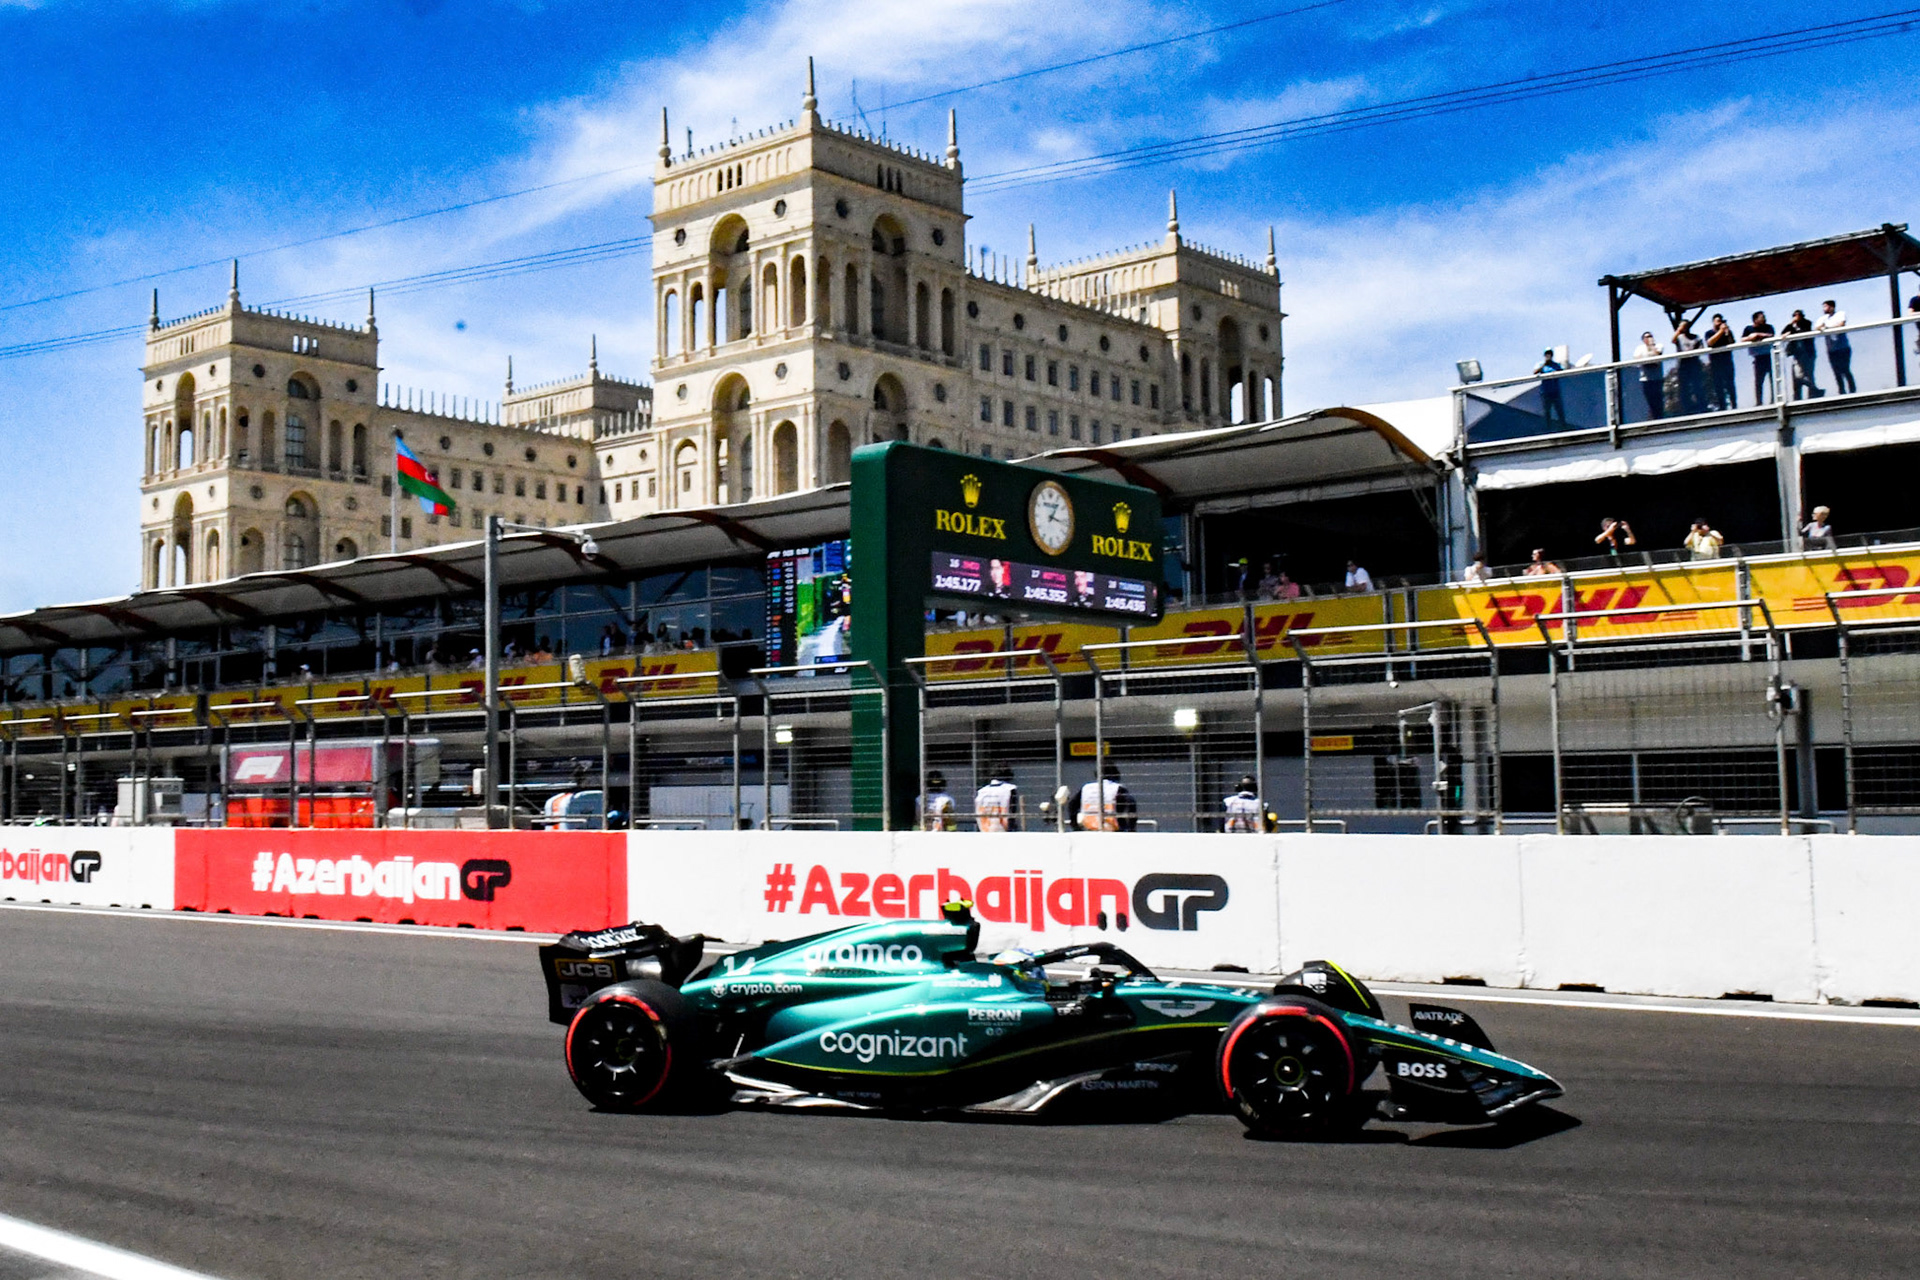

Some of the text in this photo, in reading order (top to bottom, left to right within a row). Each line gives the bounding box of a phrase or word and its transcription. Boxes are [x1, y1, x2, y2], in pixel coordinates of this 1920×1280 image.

[935, 508, 1007, 540] ROLEX
[1092, 534, 1154, 562] ROLEX
[934, 574, 982, 592] 1:45.177
[1024, 585, 1067, 603] 1:45.352
[1485, 585, 1660, 633] DHL
[1181, 612, 1327, 655] DHL
[952, 633, 1070, 672] DHL
[600, 663, 683, 694] DHL
[561, 962, 613, 978] JCB
[803, 943, 923, 973] aramco
[730, 982, 803, 996] crypto.com
[967, 1008, 1023, 1022] PERONI
[1413, 1011, 1465, 1023] AVATRADE
[819, 1028, 968, 1063] cognizant
[1397, 1062, 1447, 1079] BOSS
